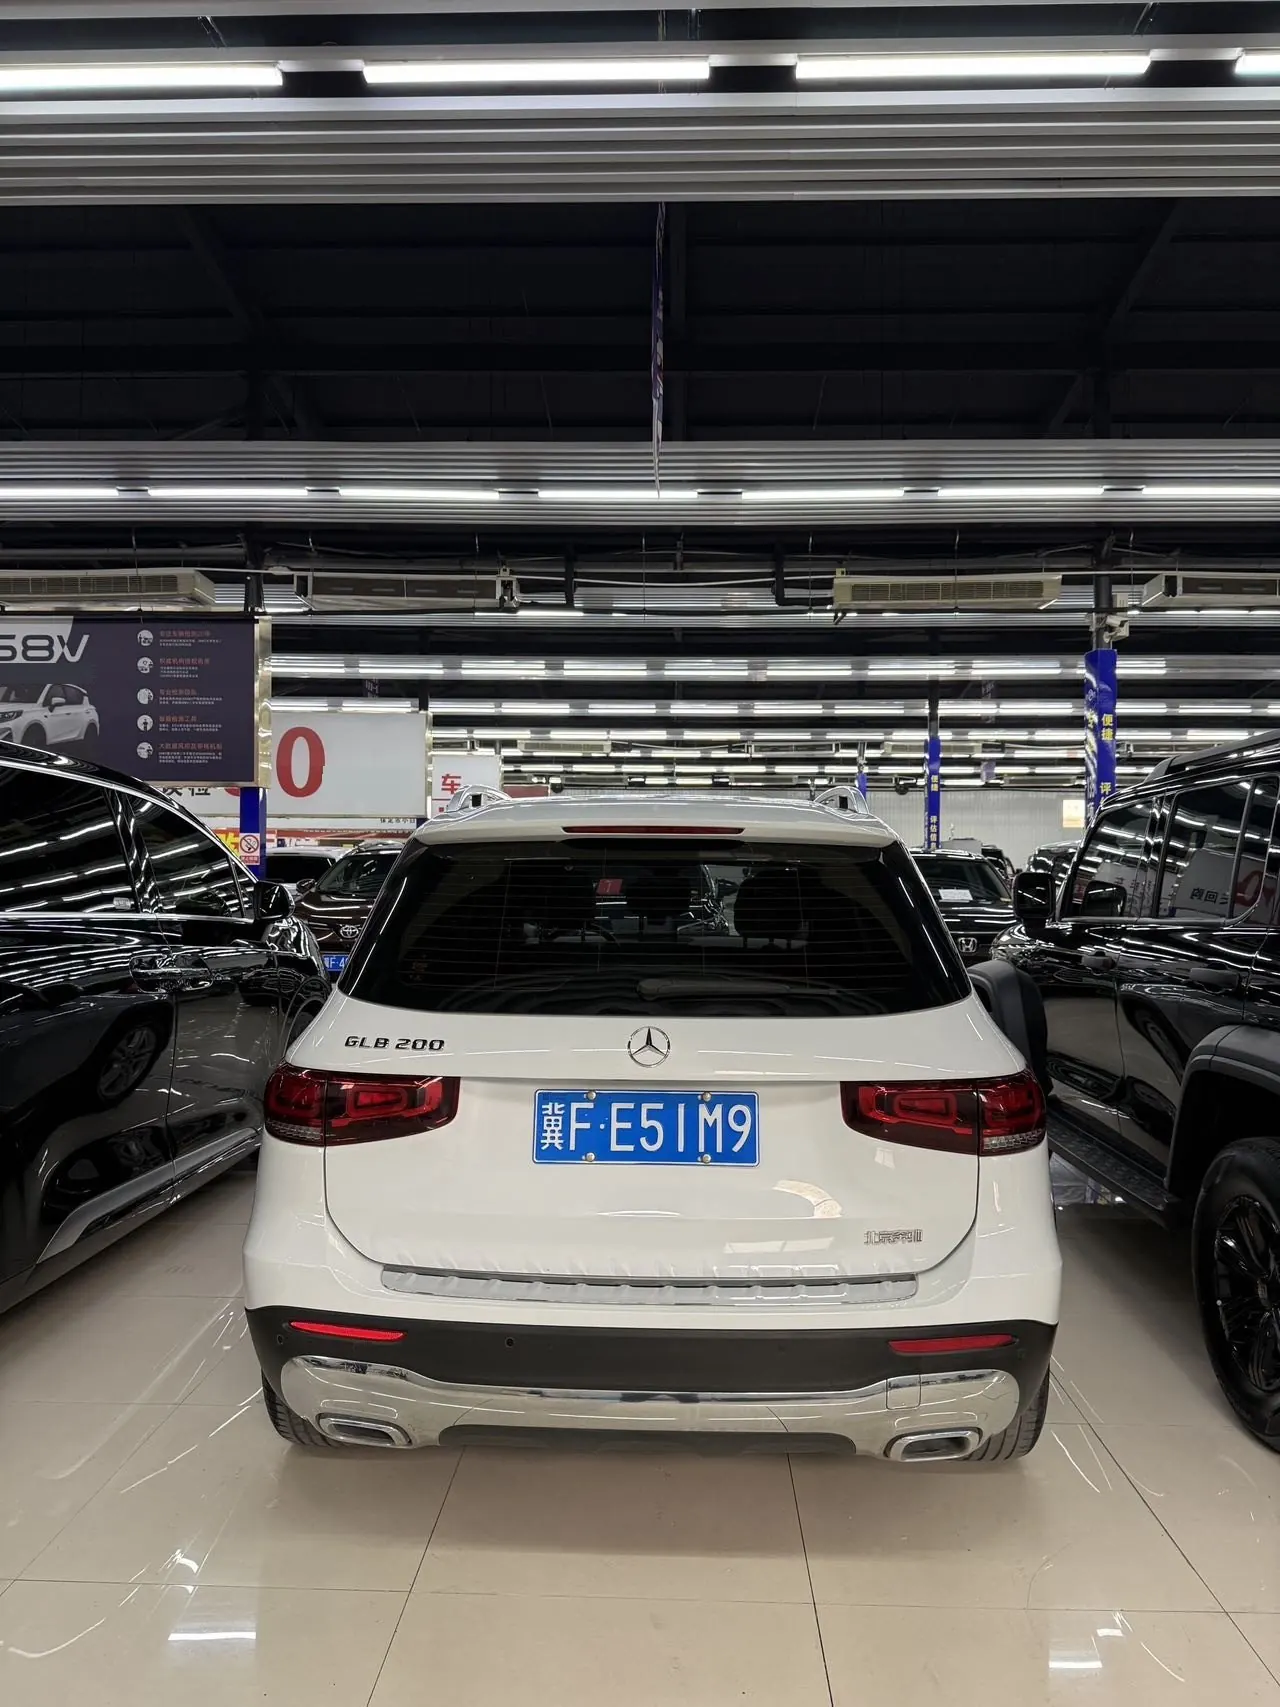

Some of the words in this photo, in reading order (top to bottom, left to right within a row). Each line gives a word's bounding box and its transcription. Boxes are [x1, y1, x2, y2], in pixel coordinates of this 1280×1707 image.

[441, 773, 462, 795] 车
[344, 1035, 390, 1049] GLB
[395, 1038, 445, 1051] 200
